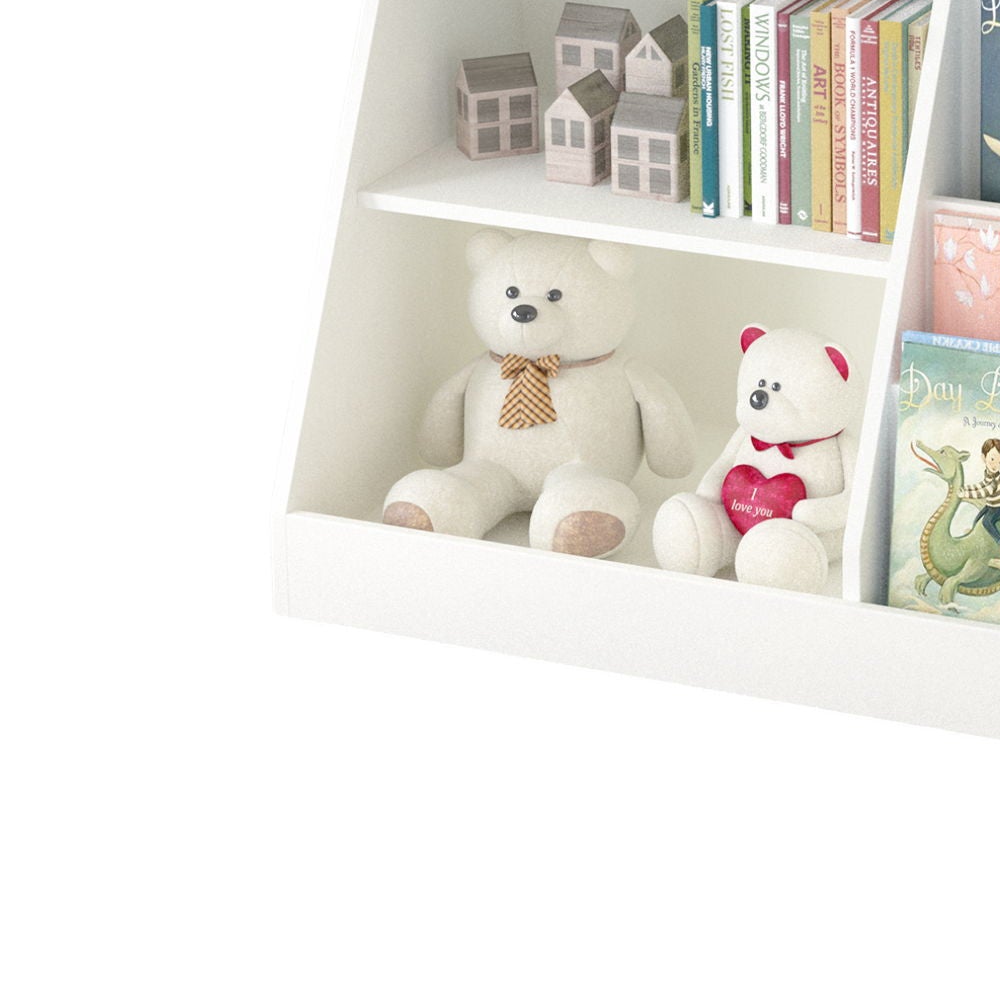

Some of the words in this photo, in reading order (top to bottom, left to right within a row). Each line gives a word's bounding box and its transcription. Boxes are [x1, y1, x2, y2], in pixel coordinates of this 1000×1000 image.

[720, 8, 734, 58] LOST
[755, 13, 771, 102] WINDOWS
[692, 62, 700, 105] Gardens
[720, 61, 735, 101] FISH
[812, 64, 827, 100] ART
[834, 62, 846, 108] BOOK
[779, 105, 787, 128] LLOYD
[849, 99, 857, 141] CHAMPIONS
[864, 76, 878, 186] ANTIQUAIRES
[834, 124, 846, 204] SYMBOLS
[900, 361, 962, 411] Day
[731, 499, 753, 513] love
[753, 506, 773, 518] you
[750, 487, 758, 501] I
